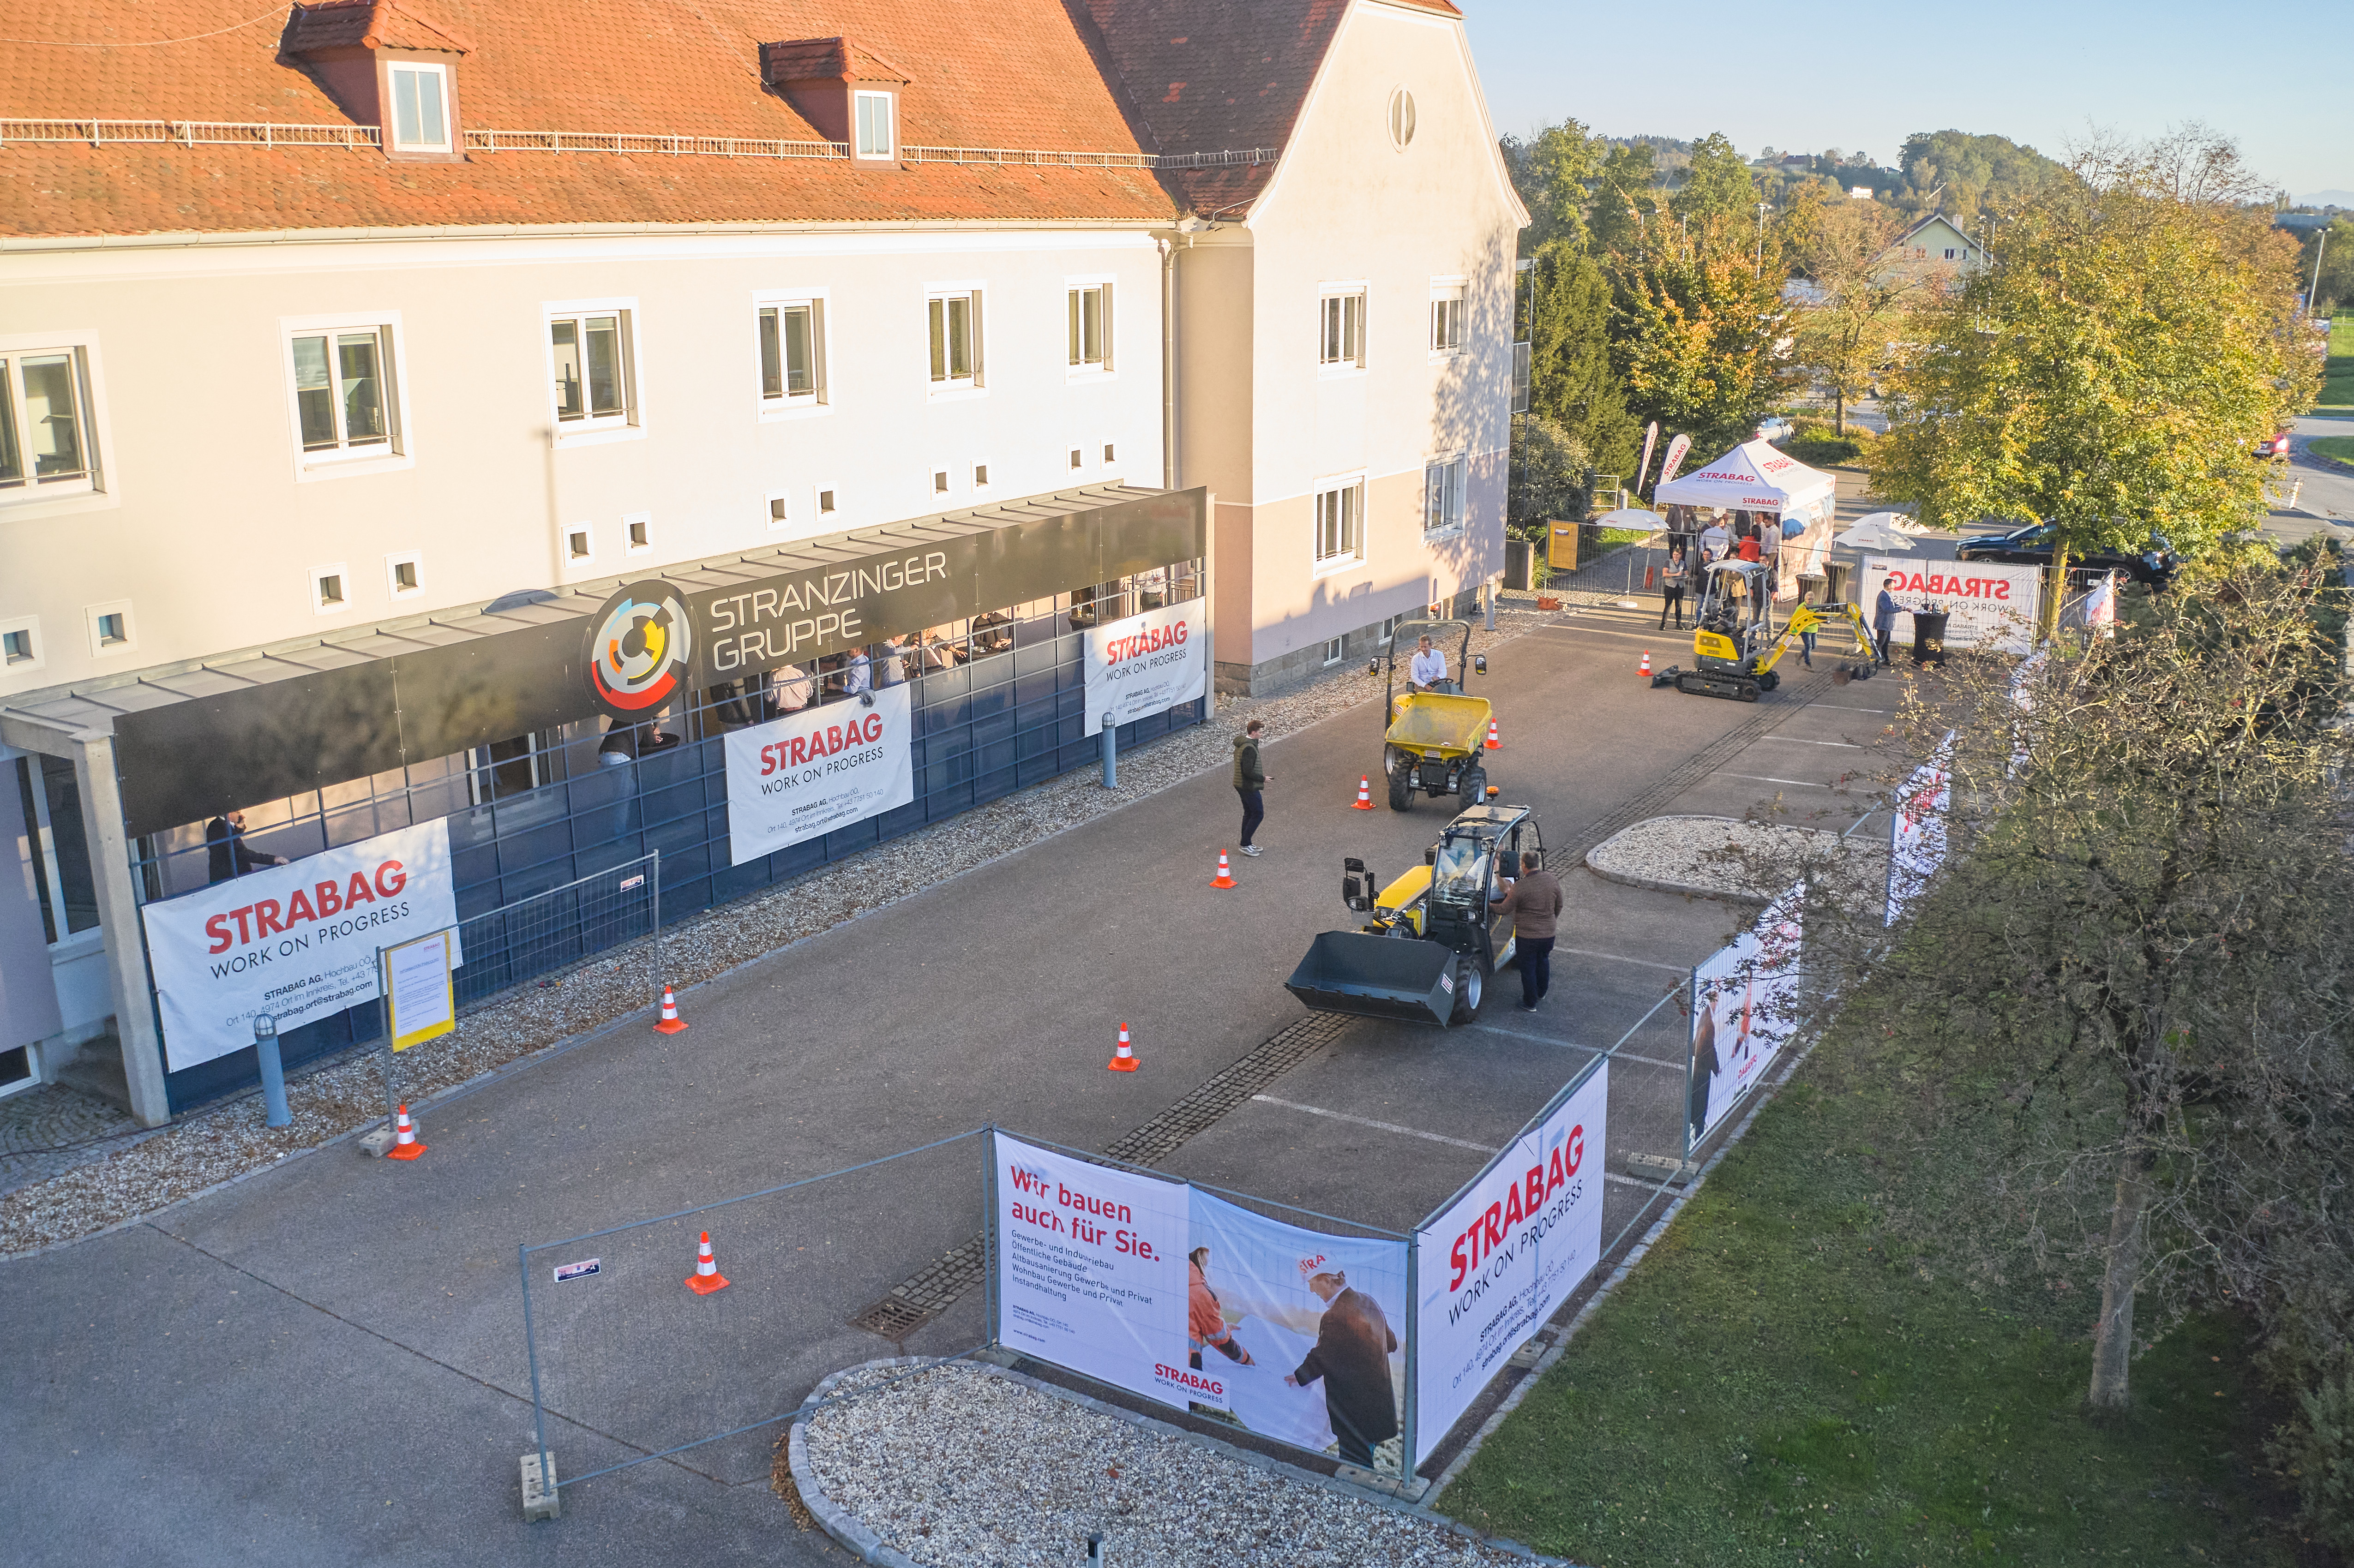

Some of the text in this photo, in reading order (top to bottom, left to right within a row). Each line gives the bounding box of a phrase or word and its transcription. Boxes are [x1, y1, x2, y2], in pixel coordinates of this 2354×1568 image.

[1664, 443, 1686, 476] STRABAG
[1698, 472, 1755, 482] STRABAG
[1763, 457, 1794, 473] STRABAG
[711, 552, 946, 632] STRANZINGER
[714, 608, 862, 671] GRUPPE
[1107, 621, 1188, 665] STRABAG
[1107, 649, 1186, 682] WORK ON PROGRESS
[1126, 690, 1143, 700] STRABAG
[761, 713, 883, 776] STRABAG
[762, 747, 883, 796] WORK ON PROGRESS
[789, 818, 800, 826] 4974
[854, 795, 865, 804] 7751
[874, 789, 883, 797] 140
[792, 803, 818, 815] STRABAG
[829, 793, 850, 803] Hochbau
[795, 807, 858, 833] strabag.ort@strabag.com
[205, 860, 407, 954] STRABAG
[210, 902, 409, 979] WORK ON PROGRESS
[424, 942, 440, 951] STRABAG
[227, 1016, 239, 1026] Ort
[261, 1002, 279, 1013] 4974
[282, 997, 293, 1006] Ort
[306, 983, 336, 997] Innkreis,
[339, 978, 350, 987] Tel.
[352, 970, 365, 982] +43
[264, 980, 306, 1000] STRABAG
[308, 974, 323, 985] AG,
[324, 962, 358, 979] Hochbau
[273, 981, 372, 1022] strabag.ort@strabag.com
[1011, 1166, 1131, 1224] Wir bauen
[1449, 1125, 1584, 1292] STRABAG
[1012, 1202, 1160, 1262] auch für Sie.
[1012, 1230, 1114, 1270] Gewerbe- und Industriebau
[1012, 1241, 1087, 1272] Öffentliche Gebäude
[1300, 1255, 1326, 1274] STRA
[1449, 1179, 1582, 1327] WORK ON PROGRESS
[1012, 1252, 1152, 1305] Altbausanierung Gewerbe und Privat
[1012, 1263, 1123, 1307] Wohnbau Gewerbe und Privat
[1013, 1274, 1066, 1301] Instandhaltung
[1013, 1305, 1029, 1313] STRABAG
[1453, 1373, 1461, 1388] Ort
[1475, 1343, 1488, 1362] 4974
[1489, 1331, 1497, 1347] Ort
[1548, 1269, 1559, 1287] 7751
[1560, 1260, 1567, 1274] 50
[1567, 1249, 1576, 1265] 140
[1480, 1306, 1507, 1342] STRABAG
[1507, 1296, 1518, 1313] AG,
[1519, 1272, 1545, 1301] Hochbau
[1482, 1294, 1550, 1371] strabag.ort@strabag.com
[1155, 1363, 1223, 1394] STRABAG
[1155, 1376, 1175, 1388] WORK
[1189, 1389, 1223, 1404] PROGRESS
